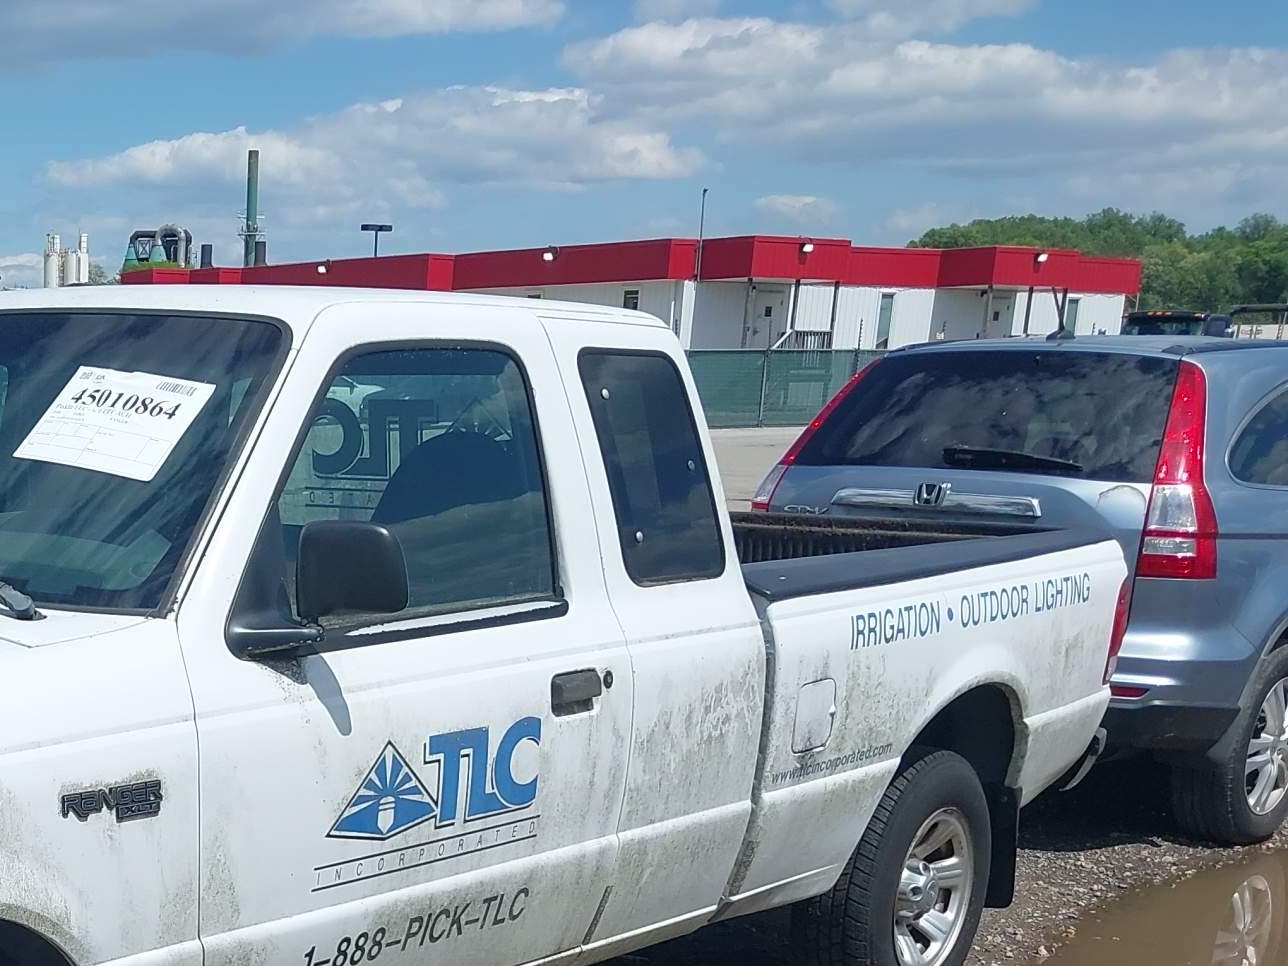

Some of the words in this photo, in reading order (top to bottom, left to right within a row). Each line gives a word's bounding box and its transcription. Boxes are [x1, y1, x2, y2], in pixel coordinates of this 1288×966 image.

[72, 388, 182, 420] 45010864
[850, 600, 940, 650] IRRIGATION
[960, 585, 1029, 628] OUTDOOR
[1034, 572, 1091, 613] LIGHTING
[61, 780, 162, 822] RANGER
[424, 716, 541, 829] TLC
[315, 821, 536, 885] INCORPORATED
